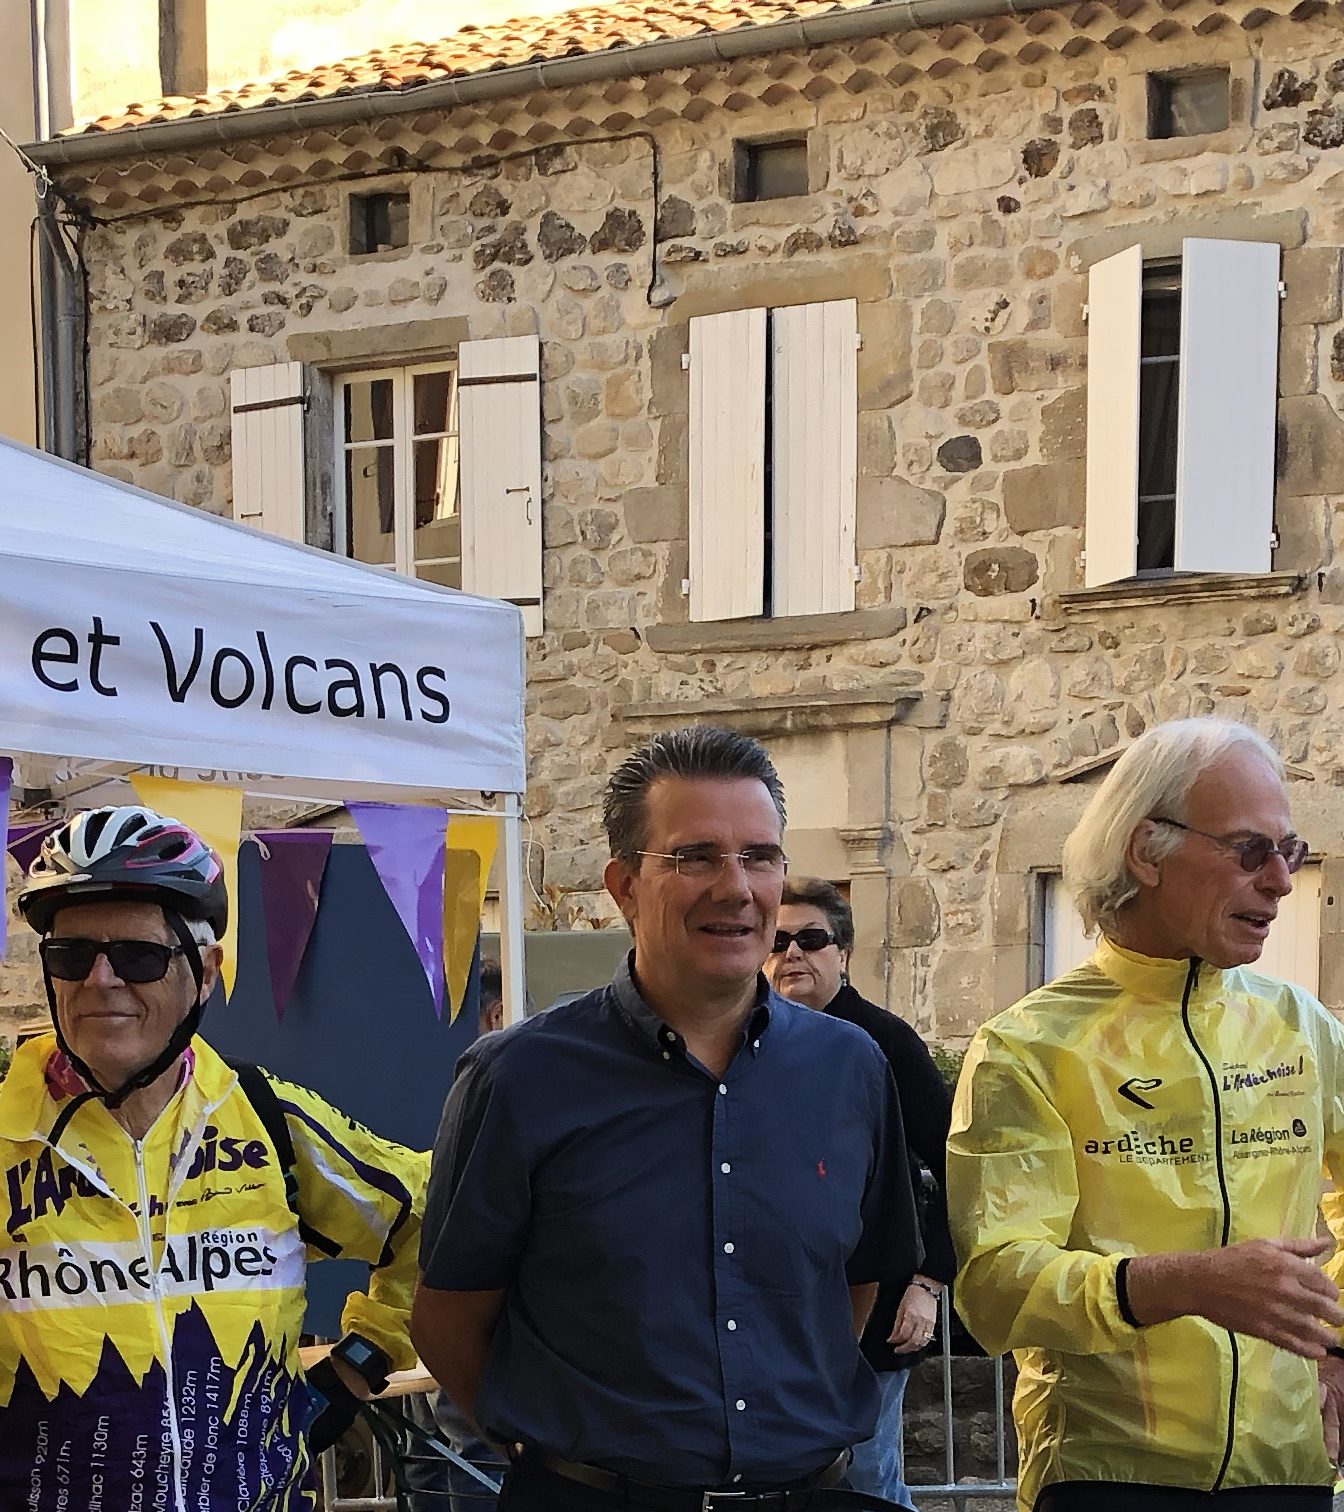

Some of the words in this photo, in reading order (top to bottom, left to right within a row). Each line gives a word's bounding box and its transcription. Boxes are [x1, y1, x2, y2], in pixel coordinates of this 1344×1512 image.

[32, 617, 120, 697] et
[149, 620, 452, 725] Volcans
[200, 1230, 258, 1248] Région
[181, 1370, 198, 1422] 1232m
[207, 1357, 221, 1409] 1417m
[35, 1420, 49, 1465] 920m
[57, 1440, 72, 1485] 671m
[91, 1415, 110, 1468] 1130m
[131, 1434, 148, 1479] 643m
[203, 1453, 216, 1475] de
